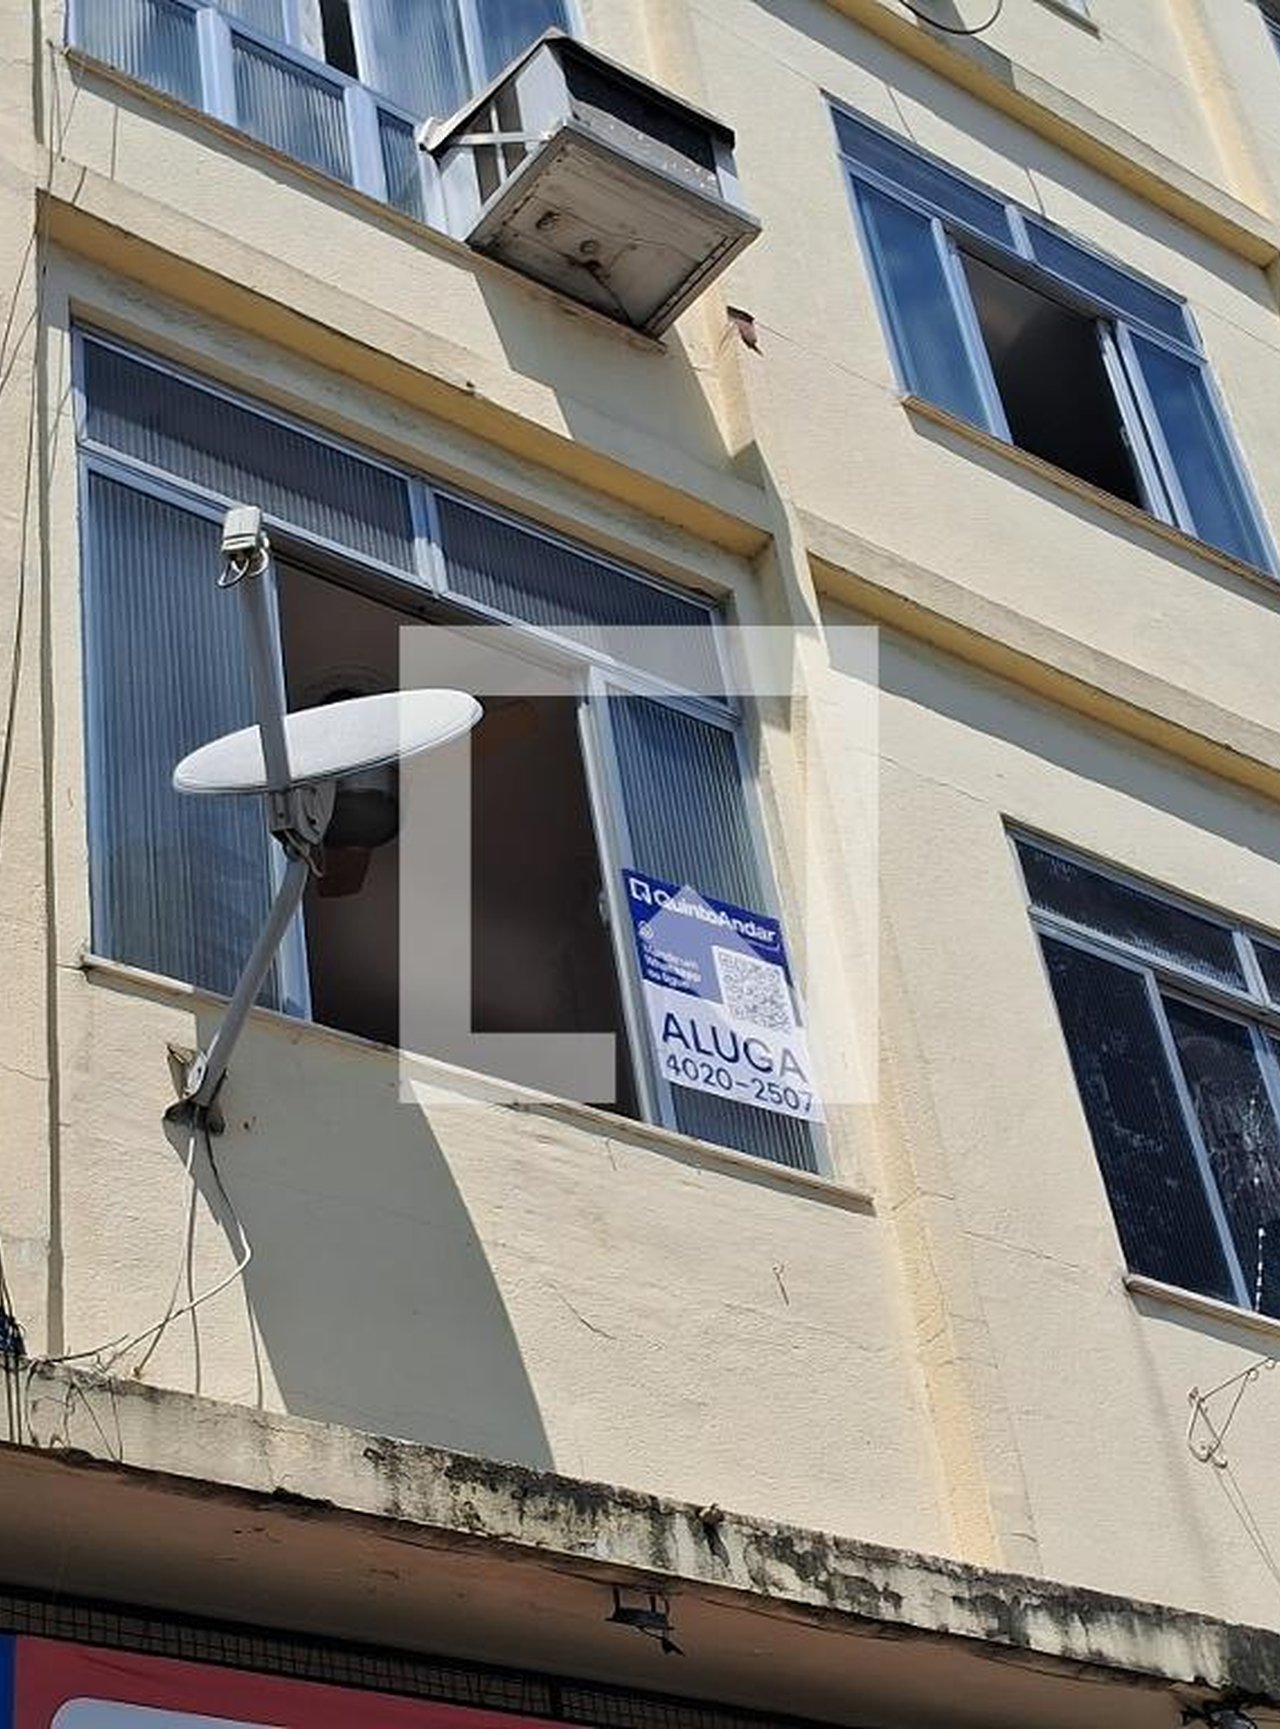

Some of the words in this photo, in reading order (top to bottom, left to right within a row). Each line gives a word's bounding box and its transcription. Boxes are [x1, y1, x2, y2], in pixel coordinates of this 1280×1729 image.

[653, 889, 776, 942] QuintoAndar
[662, 1012, 808, 1083] ALUGA
[666, 1054, 814, 1113] 4020-2507
